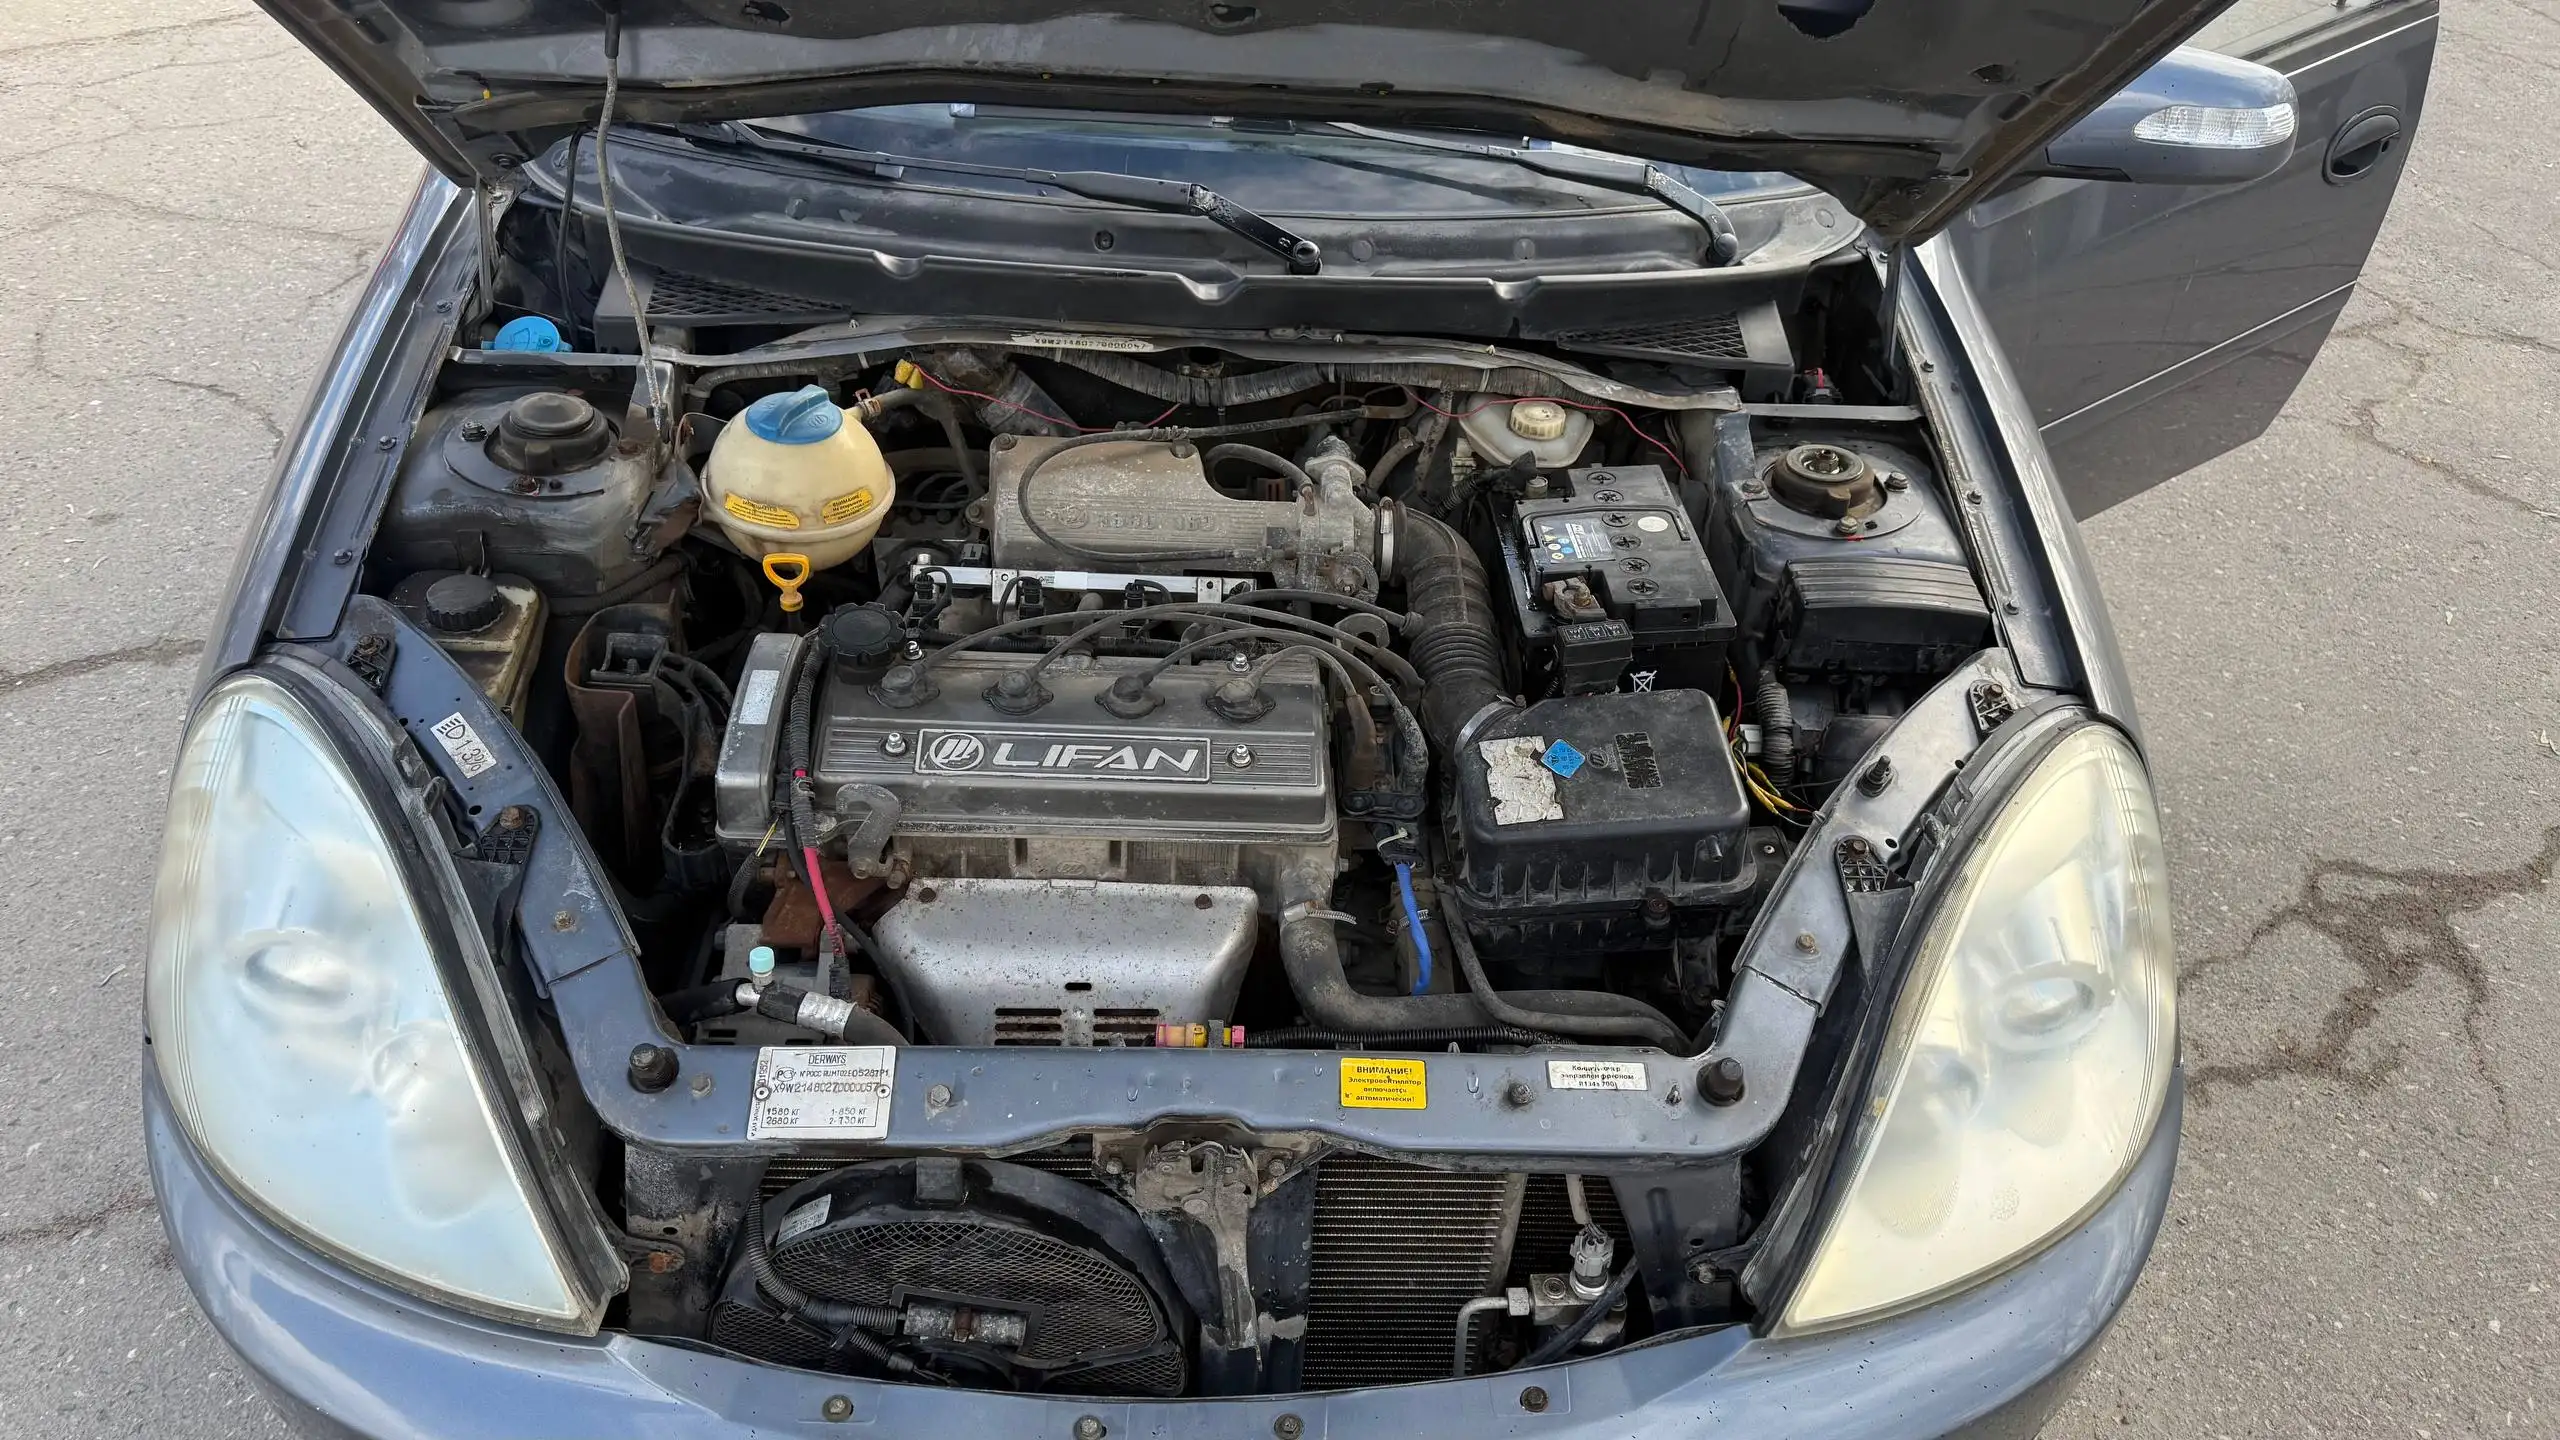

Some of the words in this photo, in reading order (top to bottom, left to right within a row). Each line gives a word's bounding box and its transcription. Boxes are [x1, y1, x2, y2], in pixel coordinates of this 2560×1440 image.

[992, 742, 1199, 772] LIFAN
[808, 1054, 847, 1065] DERWAYS
[1356, 1066, 1413, 1075] ВНИМАНИЕ!
[767, 1107, 789, 1116] 1580
[766, 1116, 789, 1125] 2680
